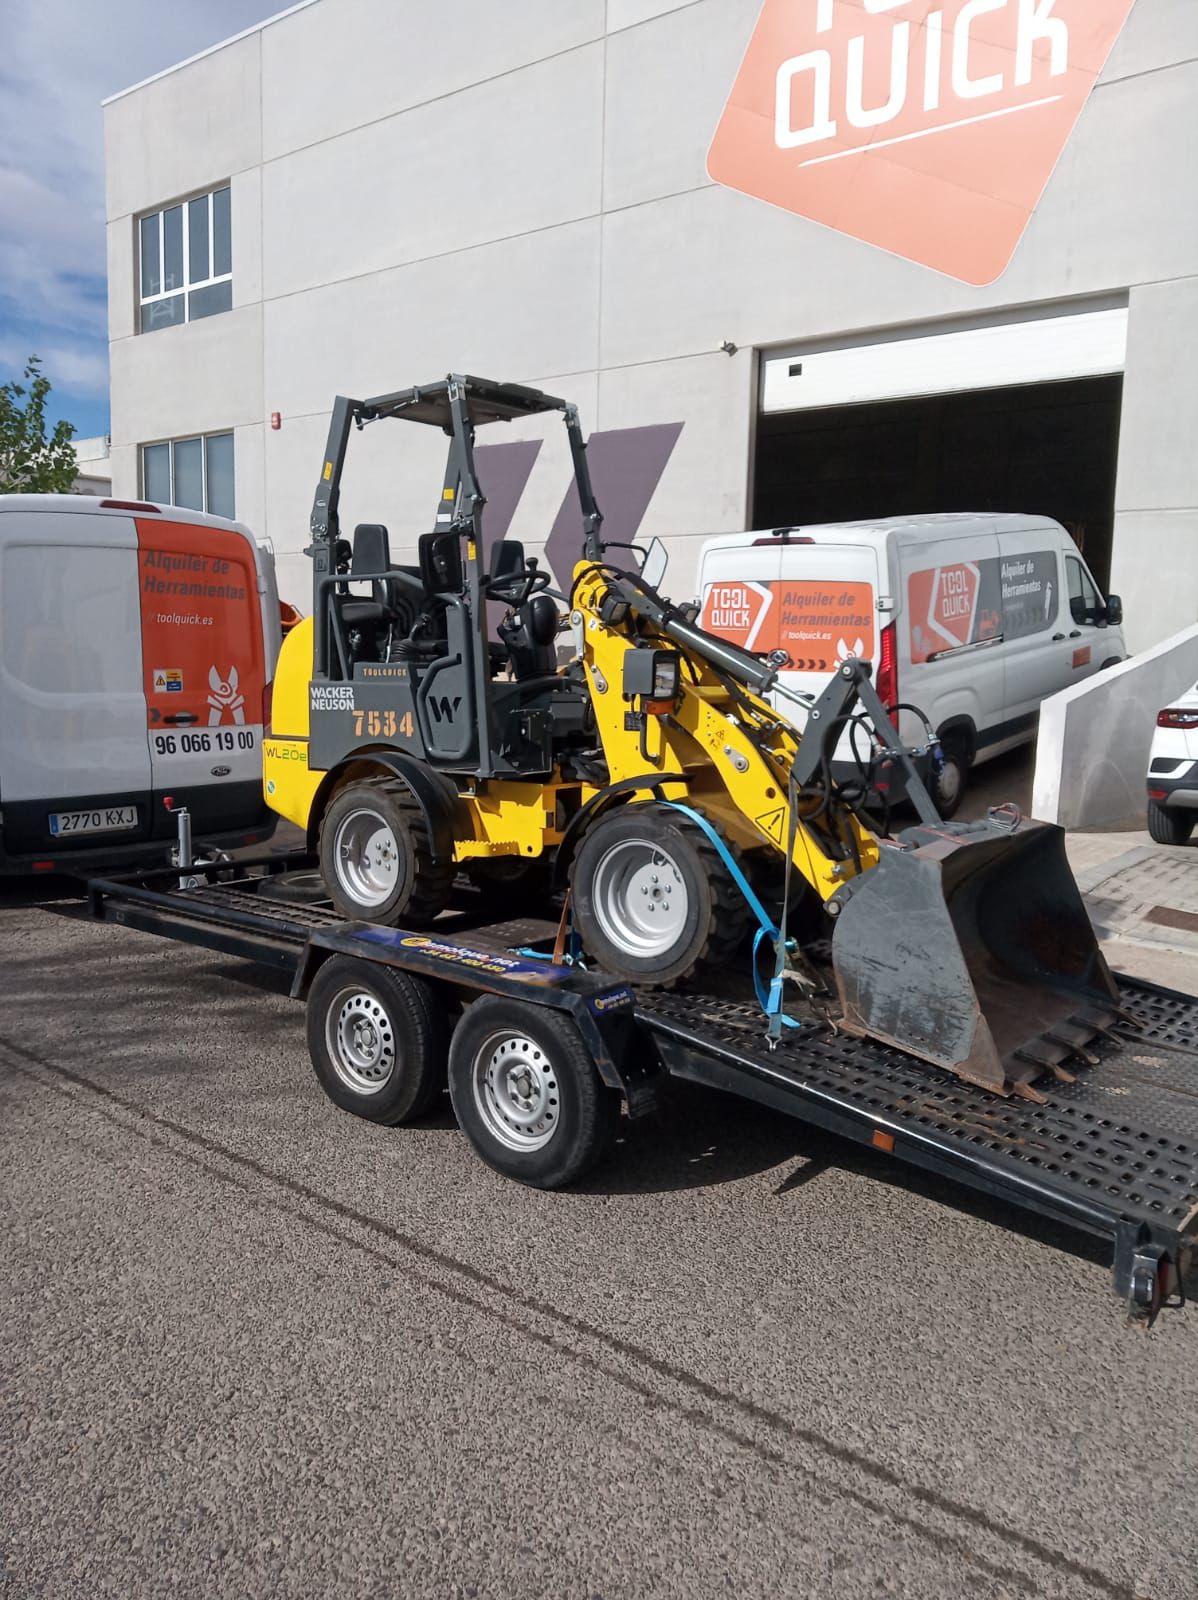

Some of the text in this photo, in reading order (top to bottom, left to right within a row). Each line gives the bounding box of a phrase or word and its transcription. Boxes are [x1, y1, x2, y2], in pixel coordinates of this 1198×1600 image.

[774, 0, 1069, 149] QUICK
[143, 549, 230, 574] Alquiler de
[1001, 559, 1035, 580] Alquiler de
[143, 575, 245, 599] Herramientas
[941, 569, 969, 596] TOOL
[1001, 580, 1041, 599] Herramientas
[711, 588, 750, 609] TOOL
[783, 591, 856, 608] Alquiler de
[943, 593, 970, 617] QUICK
[156, 612, 214, 627] toolquick.es
[711, 610, 750, 627] QUICK
[781, 612, 871, 627] Herramientas
[310, 686, 354, 699] WACKER
[311, 698, 355, 711] NEUSON
[351, 710, 414, 737] 7534
[155, 731, 254, 755] 96 066 19 00
[61, 809, 134, 831] 2770 KXJ
